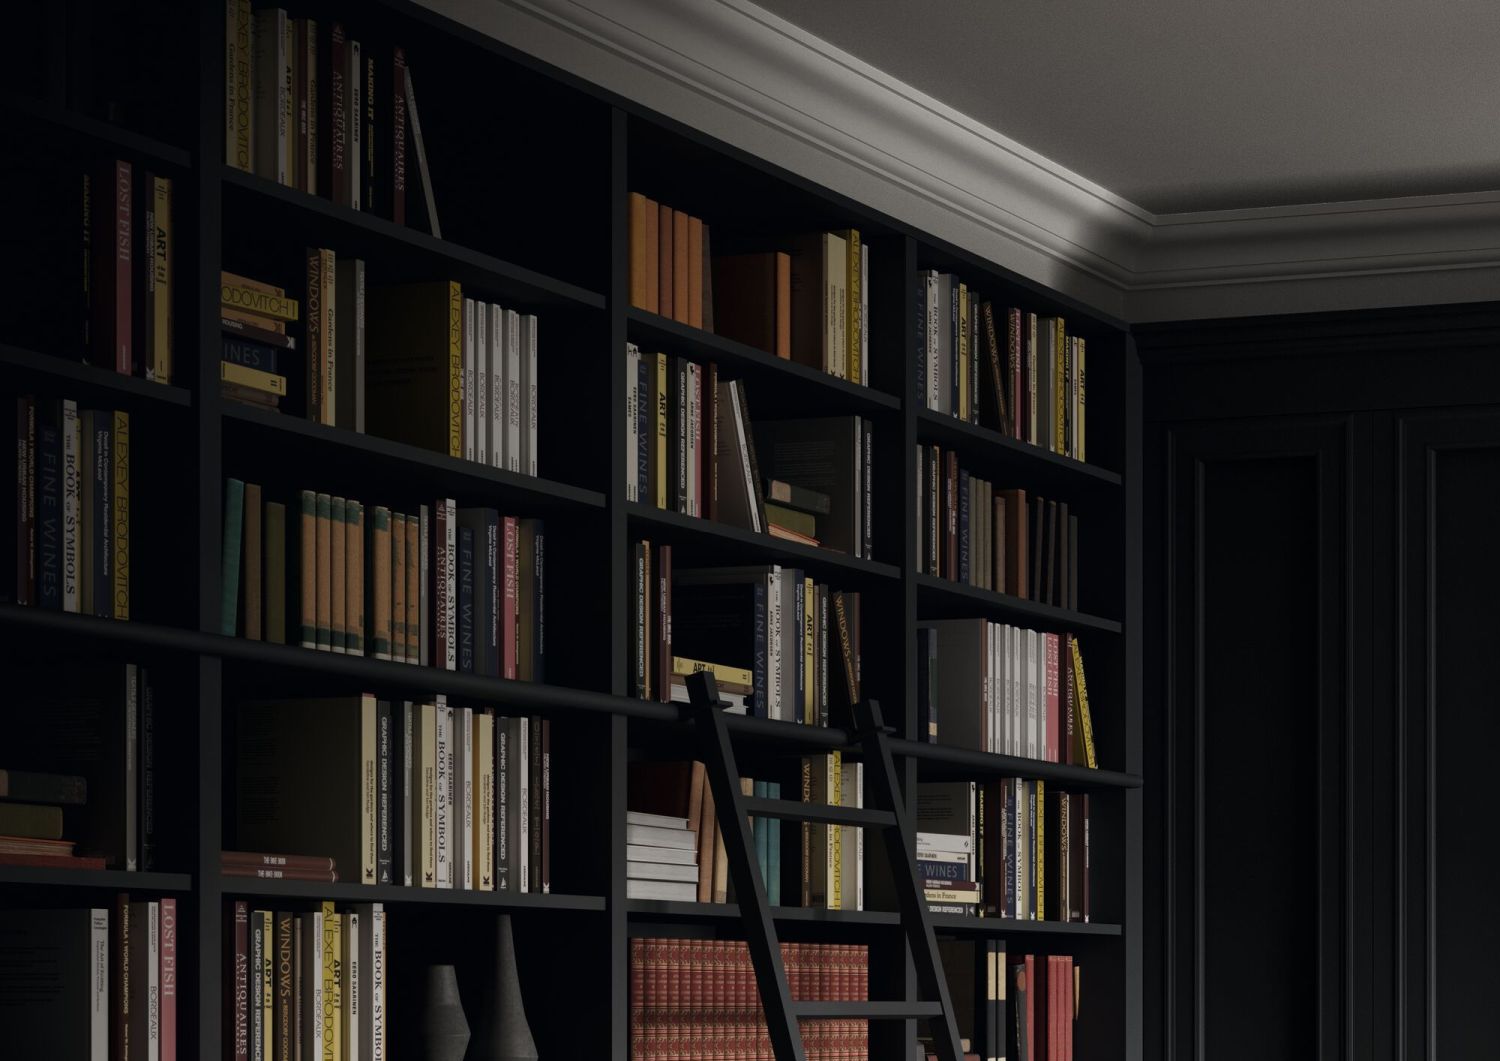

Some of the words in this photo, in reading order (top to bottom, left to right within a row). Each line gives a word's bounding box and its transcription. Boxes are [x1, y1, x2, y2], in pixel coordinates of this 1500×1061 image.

[119, 167, 130, 216] LOST
[119, 219, 130, 262] FISH
[156, 226, 167, 261] ART
[222, 286, 288, 316] ODOVITCH
[309, 255, 320, 334] WINDOWS
[451, 286, 461, 349] ALEXEY
[224, 343, 260, 365] INES
[43, 452, 57, 507] FINE
[67, 454, 75, 497] BOOK
[117, 417, 128, 492] ALEXEY
[639, 434, 647, 494] WINES
[43, 518, 57, 597] WINES
[67, 515, 75, 594] SYMBOLS
[117, 497, 128, 619] BRODOVITCH
[506, 522, 515, 560] LOST
[463, 549, 471, 594] FINE
[506, 564, 515, 599] FISH
[463, 603, 471, 669] WINES
[835, 594, 850, 657] WINDOWS
[925, 865, 957, 878] WINES
[164, 905, 174, 951] LOST
[324, 906, 334, 972] ALEXEY
[164, 954, 174, 995] FISH
[281, 918, 291, 997] WINDOWS
